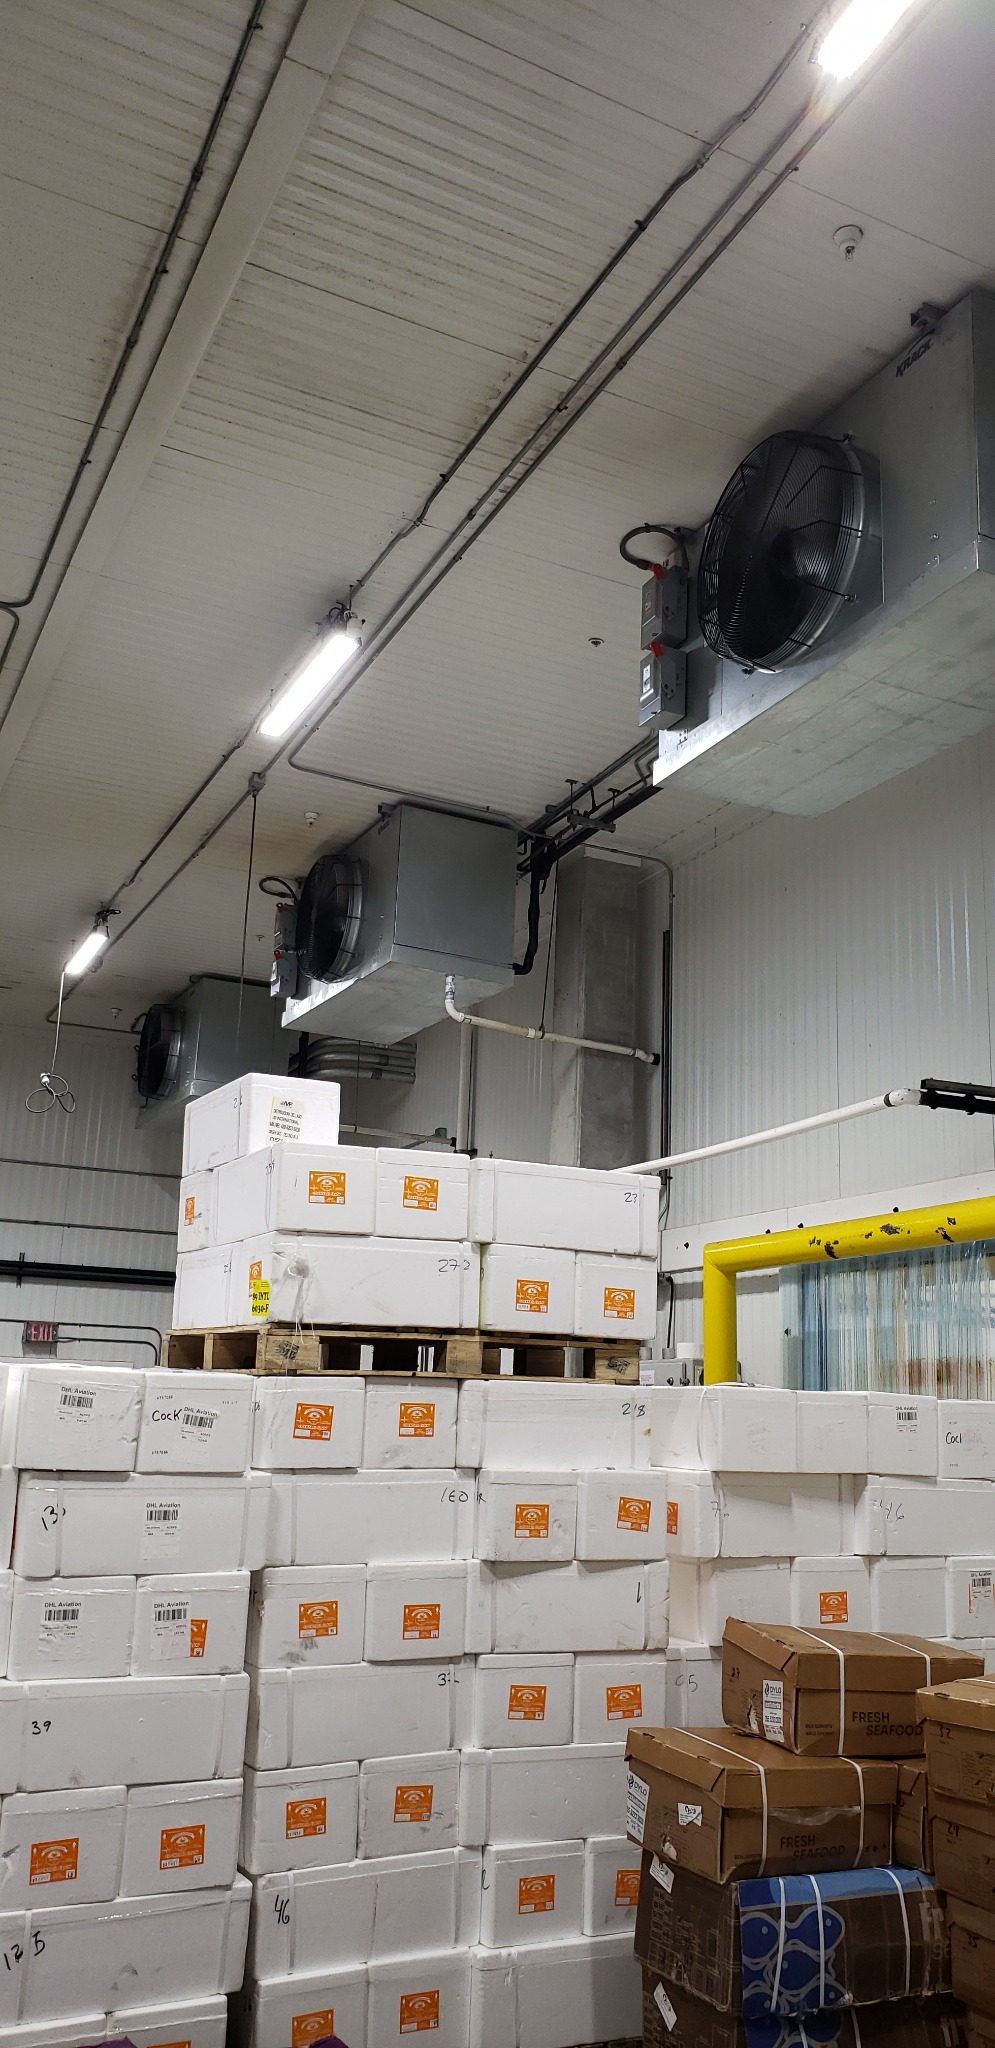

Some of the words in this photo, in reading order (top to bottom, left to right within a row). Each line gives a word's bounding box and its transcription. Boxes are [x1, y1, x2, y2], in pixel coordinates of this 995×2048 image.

[30, 1323, 53, 1342] EXIT
[195, 1408, 218, 1418] Aviation
[166, 1600, 190, 1608] Aviation
[770, 1686, 782, 1694] DYLO
[852, 1711, 890, 1723] FRESH
[31, 1720, 52, 1735] 39
[865, 1724, 924, 1737] SEAFOOD
[780, 1835, 816, 1849] FRESH
[793, 1845, 846, 1859] SEAFOOD
[274, 1893, 290, 1925] 46
